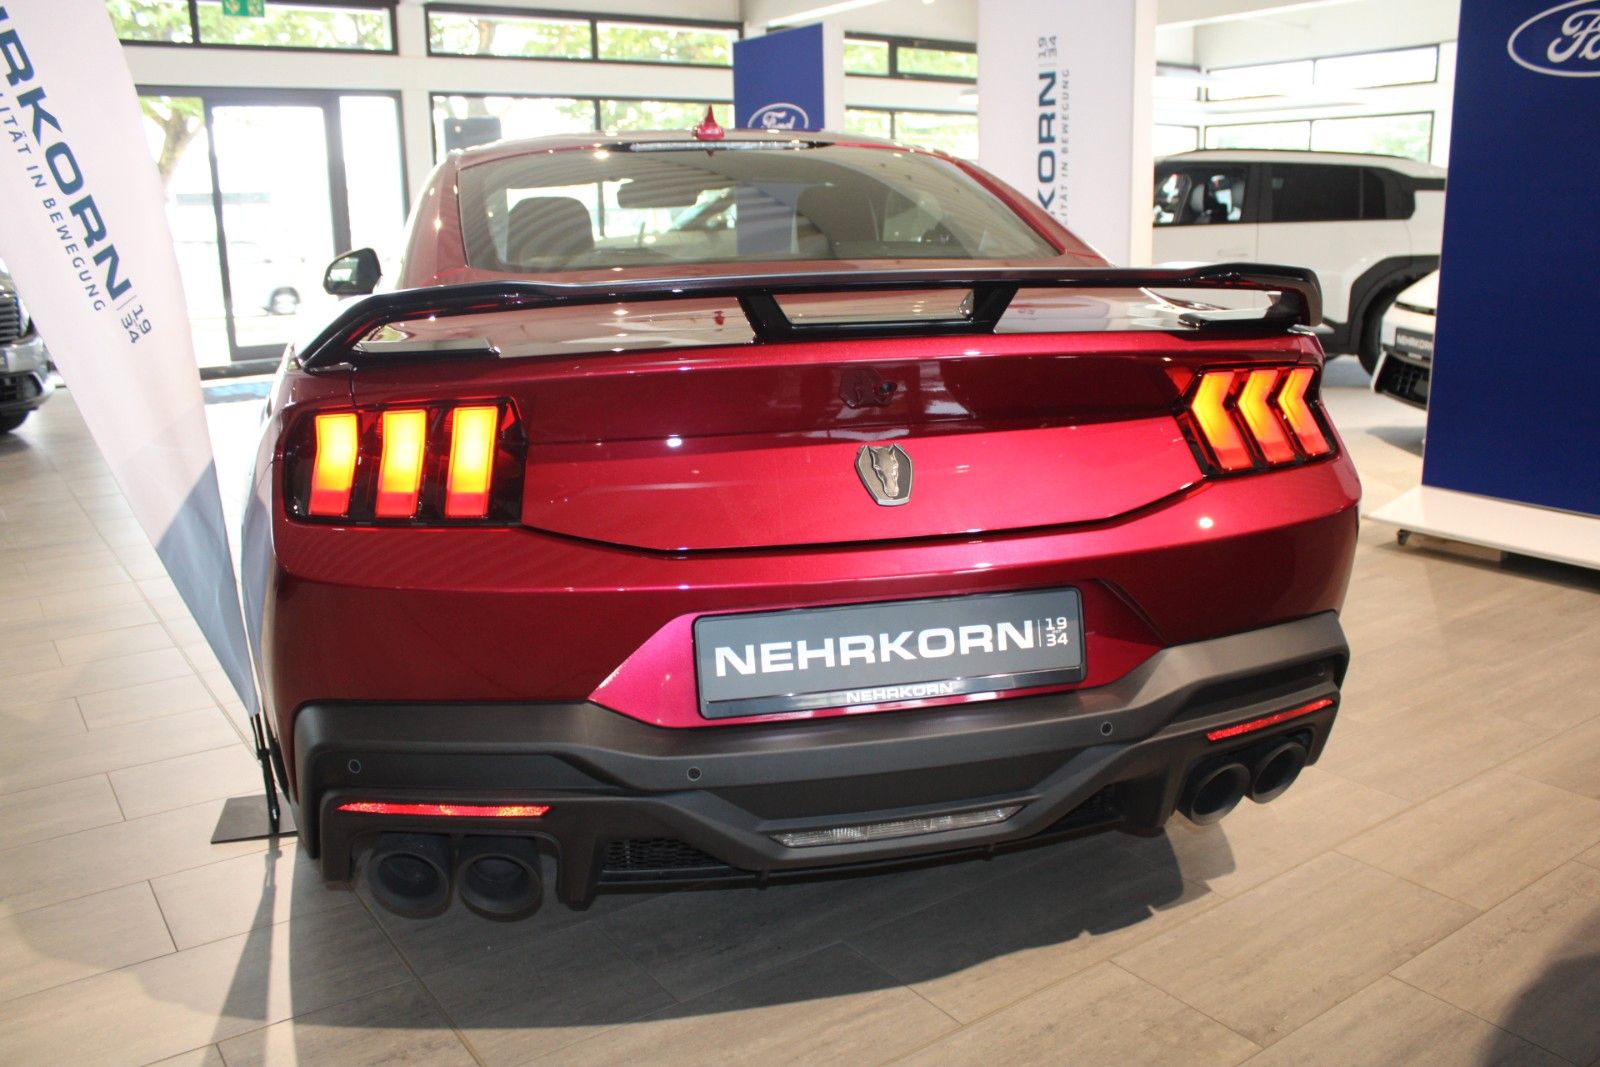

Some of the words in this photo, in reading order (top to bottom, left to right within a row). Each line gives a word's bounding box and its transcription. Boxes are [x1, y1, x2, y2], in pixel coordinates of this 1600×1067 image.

[1061, 69, 1070, 154] BEWEGUNG
[0, 6, 132, 301] RKORN
[1061, 161, 1068, 177] IN
[0, 92, 31, 155] ITÄT
[26, 164, 47, 189] IN
[42, 197, 106, 312] BEWEGUNG
[120, 313, 140, 344] 34
[132, 304, 152, 335] 19
[1045, 616, 1067, 631] 19
[714, 619, 1034, 677] NEHRKORN
[1046, 632, 1068, 647] 34
[846, 681, 954, 704] NEHRKORN
